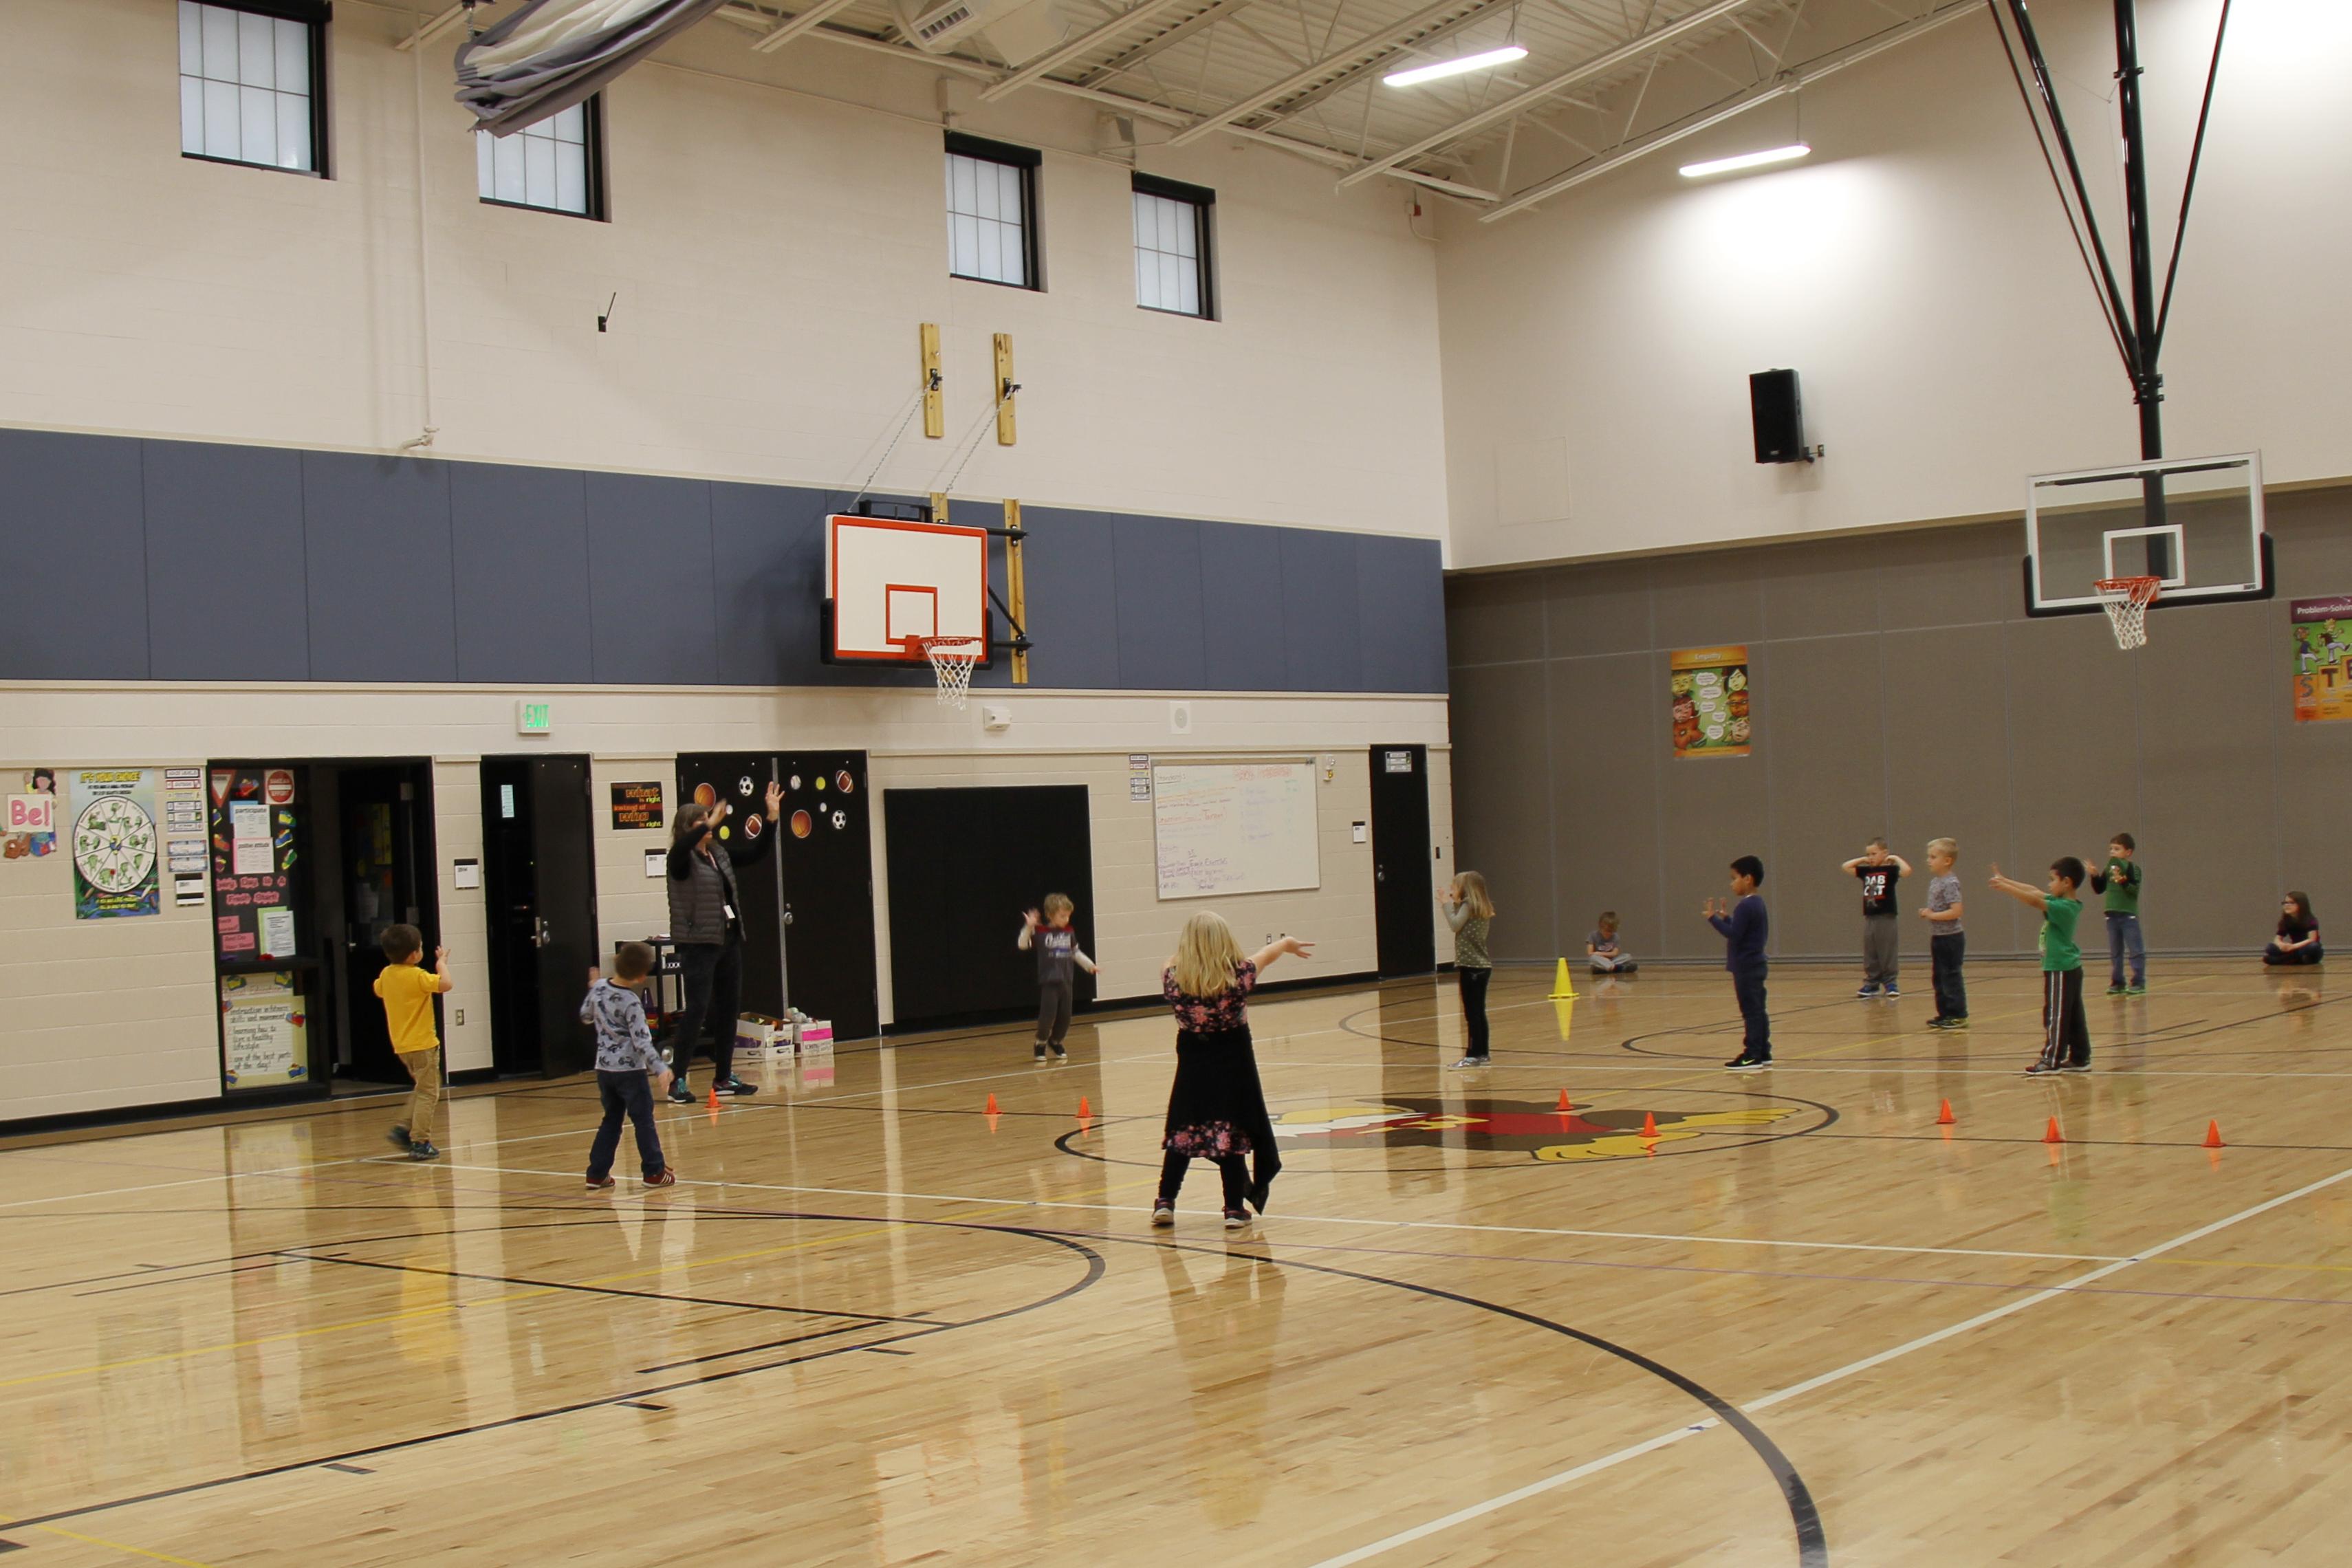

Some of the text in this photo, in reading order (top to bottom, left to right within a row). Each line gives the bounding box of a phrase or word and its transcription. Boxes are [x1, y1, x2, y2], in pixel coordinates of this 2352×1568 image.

[525, 704, 549, 728] EXIT
[626, 787, 660, 798] what
[11, 799, 51, 827] Be!
[619, 812, 650, 822] who
[1865, 875, 1886, 886] DAB
